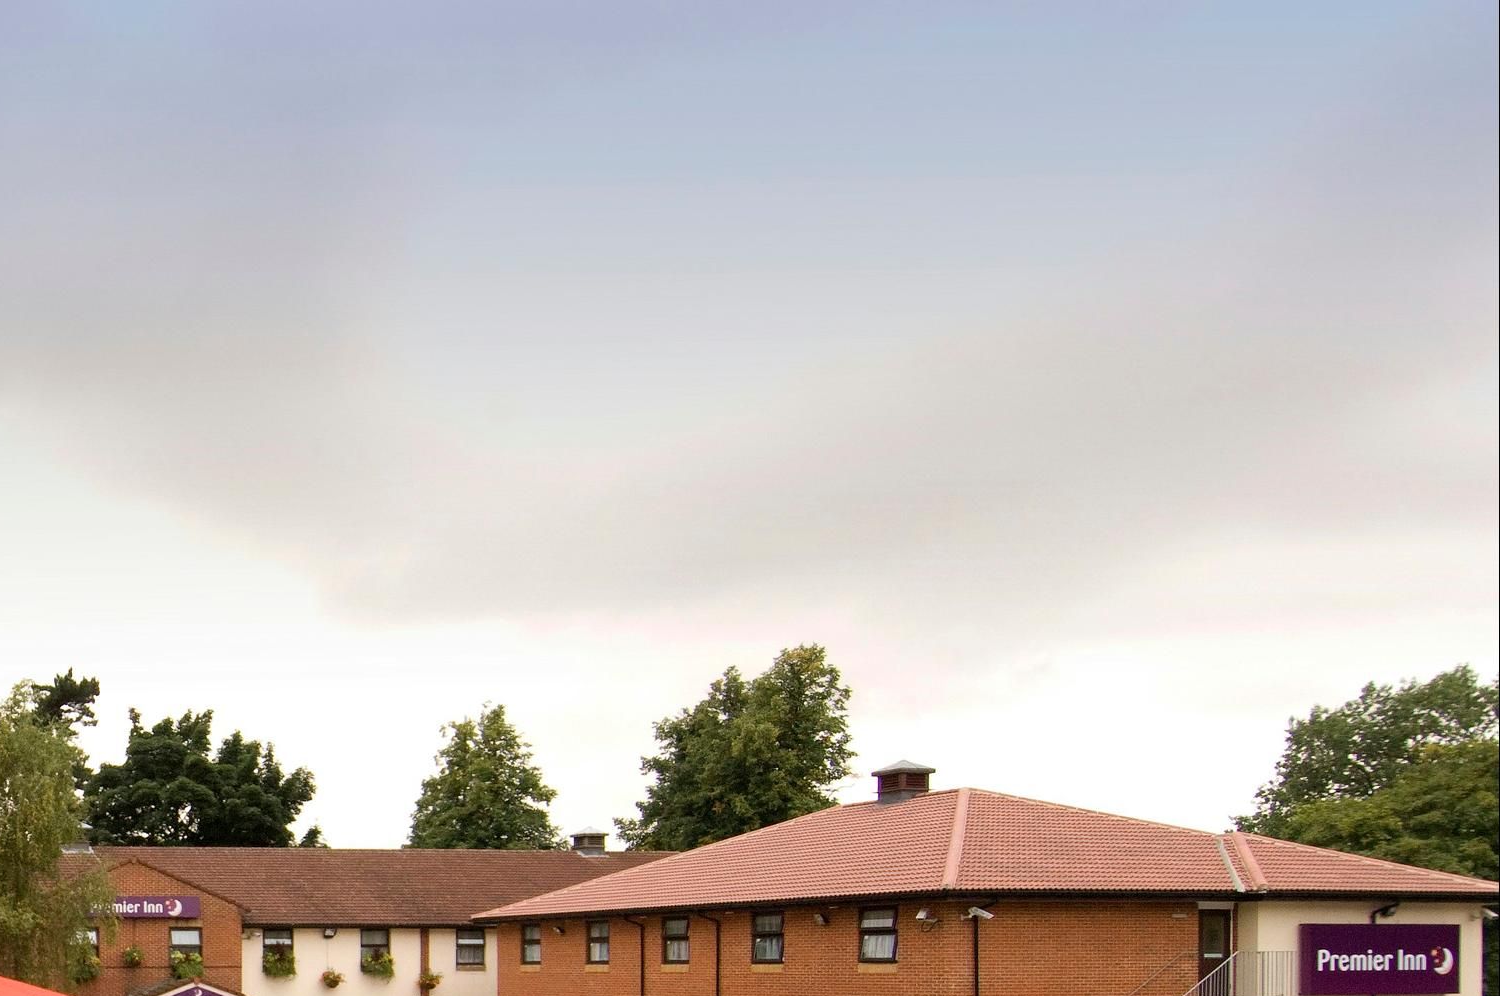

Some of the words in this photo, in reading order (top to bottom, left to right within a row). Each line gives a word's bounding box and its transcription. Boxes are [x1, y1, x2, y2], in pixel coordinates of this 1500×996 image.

[143, 900, 164, 914] Inn
[1316, 948, 1393, 972] Premier
[1397, 949, 1428, 971] Inn
